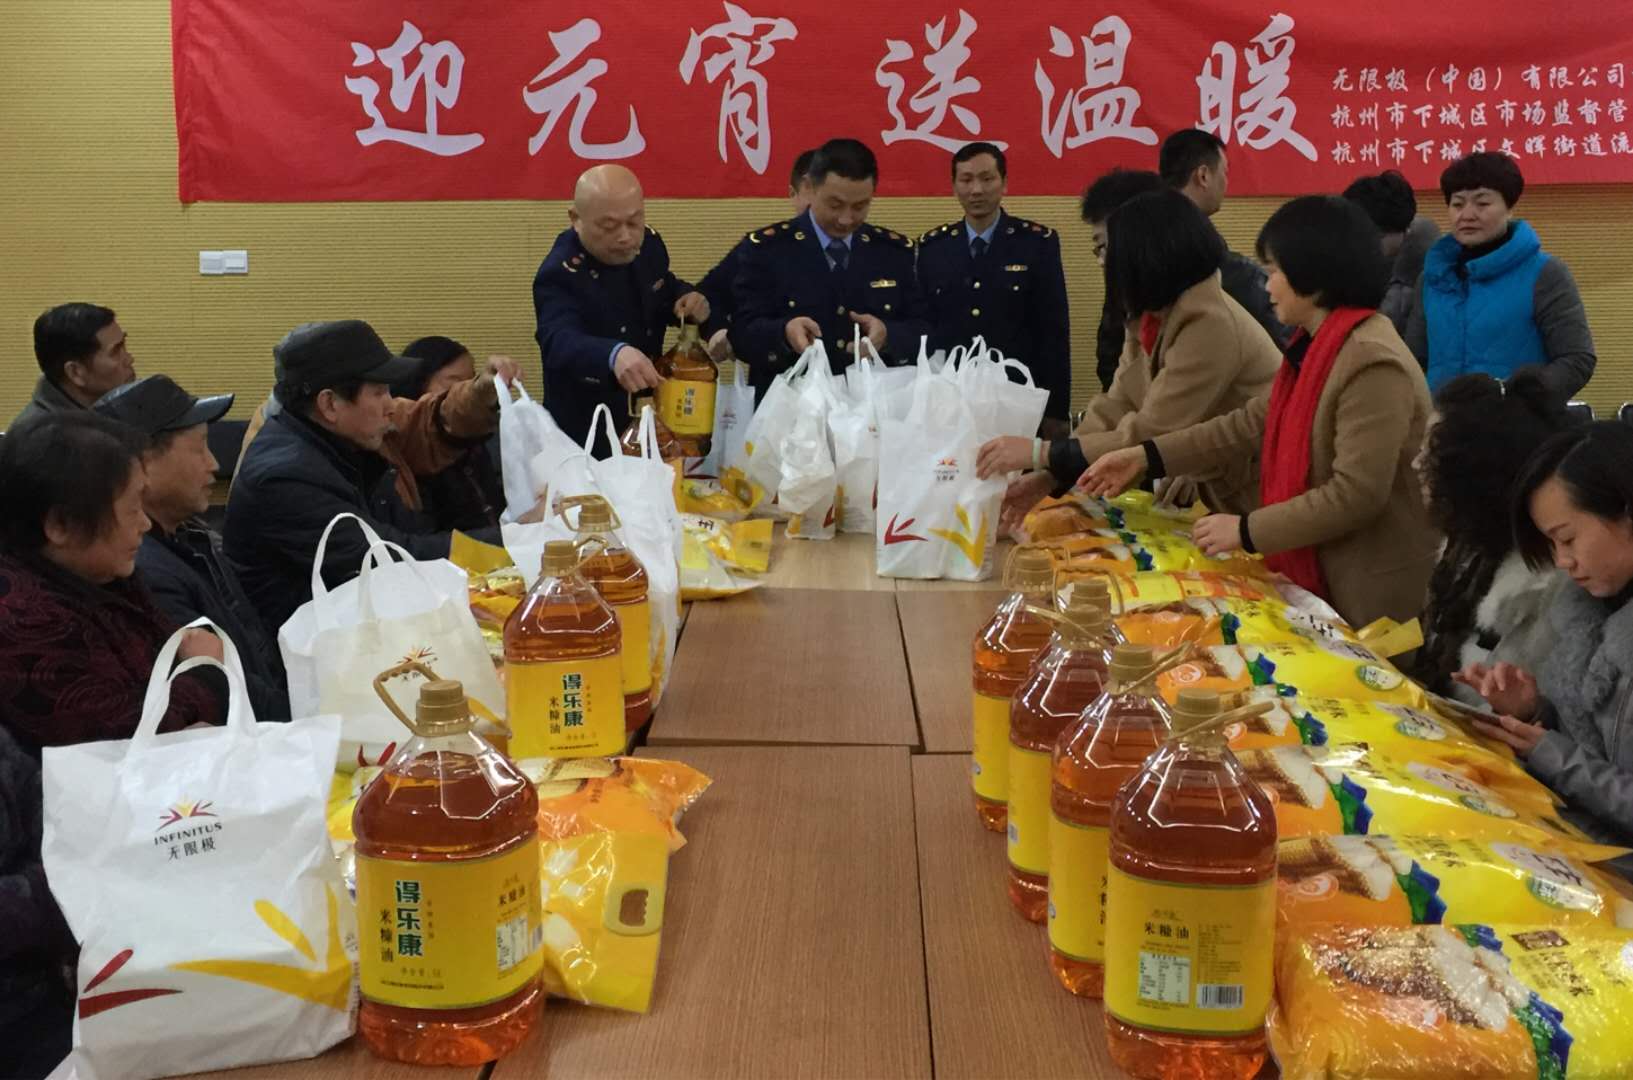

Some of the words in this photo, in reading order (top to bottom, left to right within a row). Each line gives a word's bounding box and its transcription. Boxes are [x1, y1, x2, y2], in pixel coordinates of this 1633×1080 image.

[345, 1, 798, 175] 迎元宵
[876, 8, 1319, 162] 送温暖
[1332, 62, 1633, 94] 无限极（中国）有限公司
[1331, 98, 1628, 131] 杭州市下城区市场监督管
[562, 673, 583, 727] 得乐康
[154, 822, 222, 846] INFINITUS
[168, 836, 216, 861] 无限极
[396, 880, 423, 957] 得乐康
[1144, 921, 1189, 939] 米糠油
[380, 909, 393, 963] 米糠油
